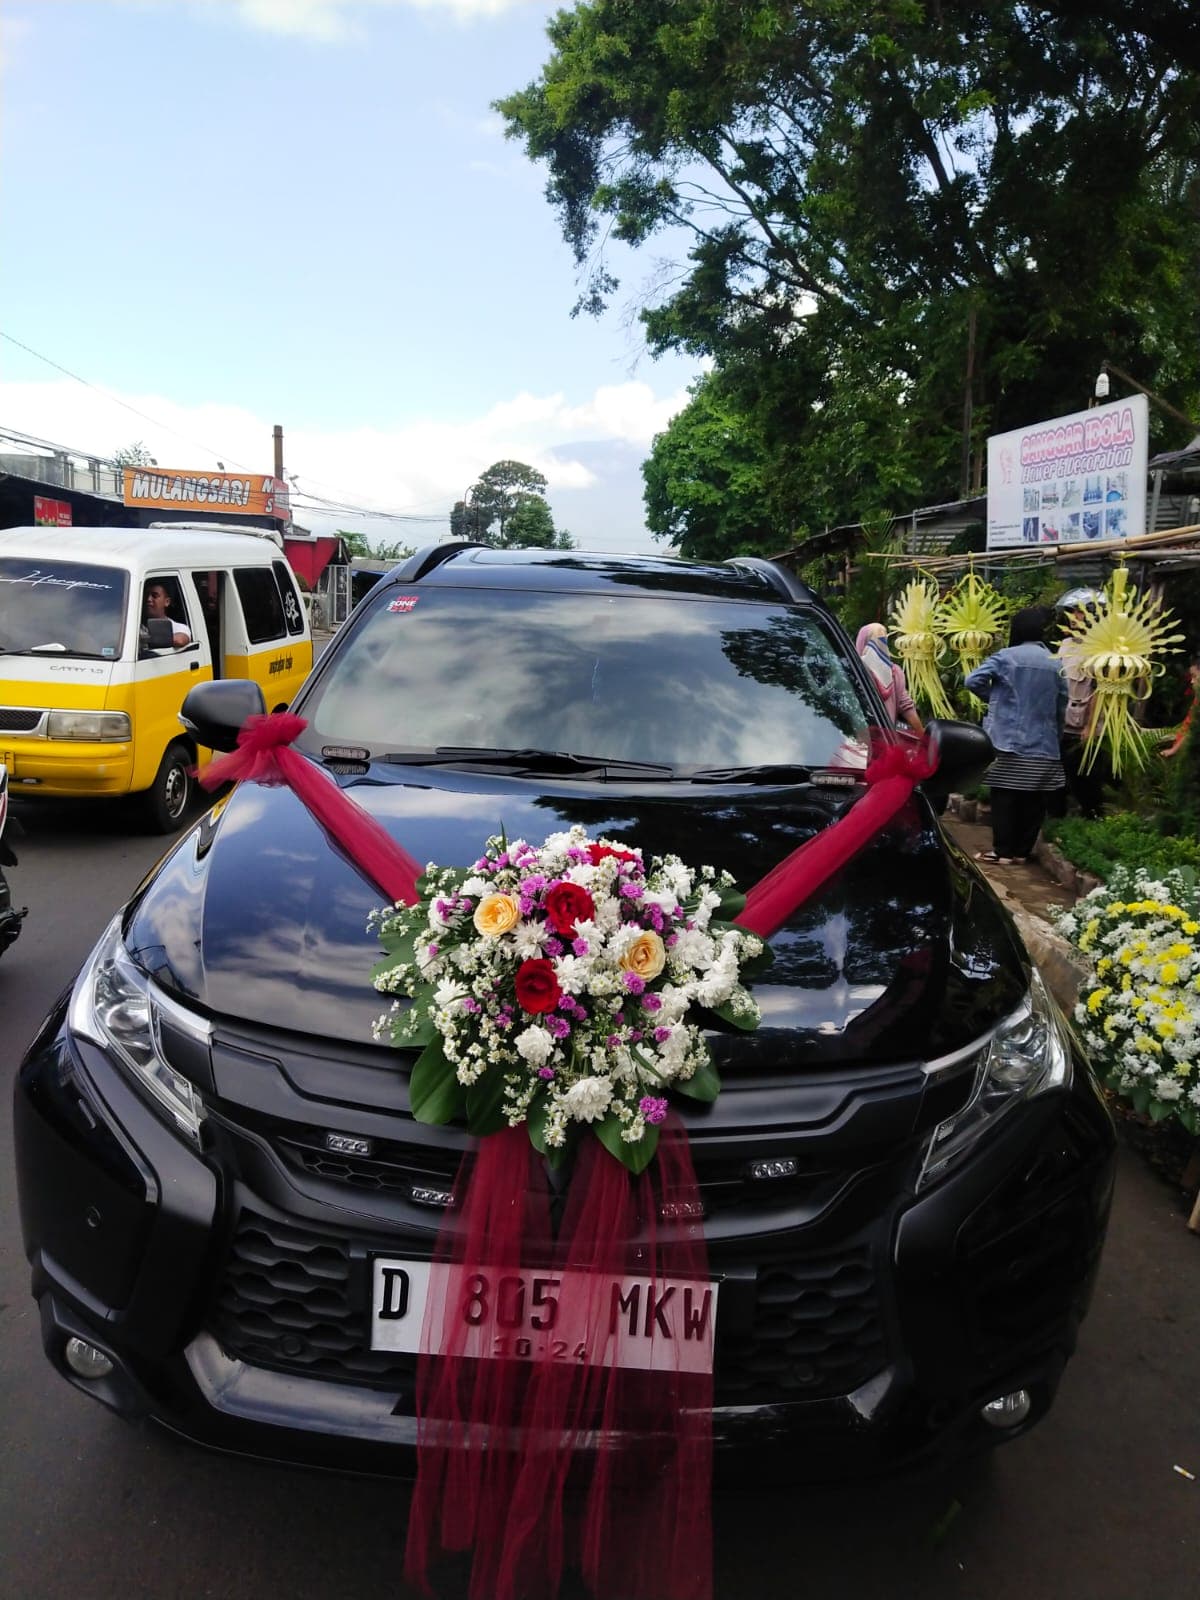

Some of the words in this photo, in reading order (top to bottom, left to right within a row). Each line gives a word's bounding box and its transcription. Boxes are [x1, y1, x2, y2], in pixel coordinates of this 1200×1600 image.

[1085, 408, 1135, 450] IDOLA
[132, 473, 250, 506] MULANGSARI
[377, 1267, 410, 1321] D
[462, 1272, 562, 1332] 805
[608, 1280, 713, 1342] MKW
